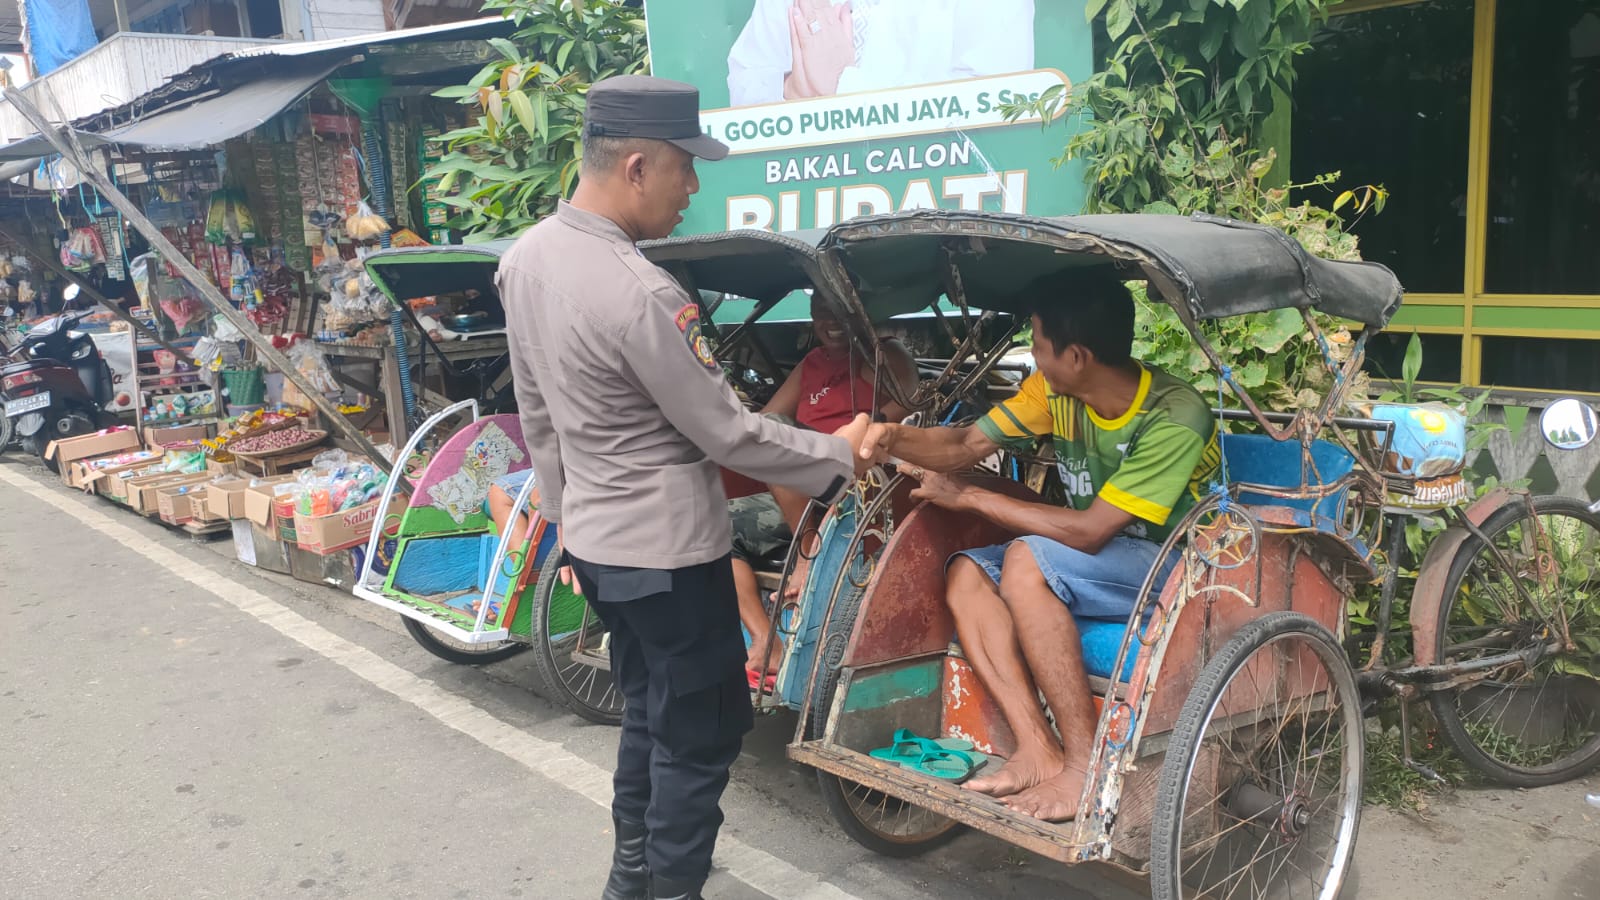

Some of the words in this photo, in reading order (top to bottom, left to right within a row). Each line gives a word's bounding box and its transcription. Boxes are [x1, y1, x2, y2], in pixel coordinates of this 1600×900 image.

[725, 116, 793, 141] GOGO
[800, 103, 899, 133] PURMAN
[907, 96, 969, 122] JAYA,
[766, 153, 857, 183] BAKAL
[865, 141, 970, 173] CALON
